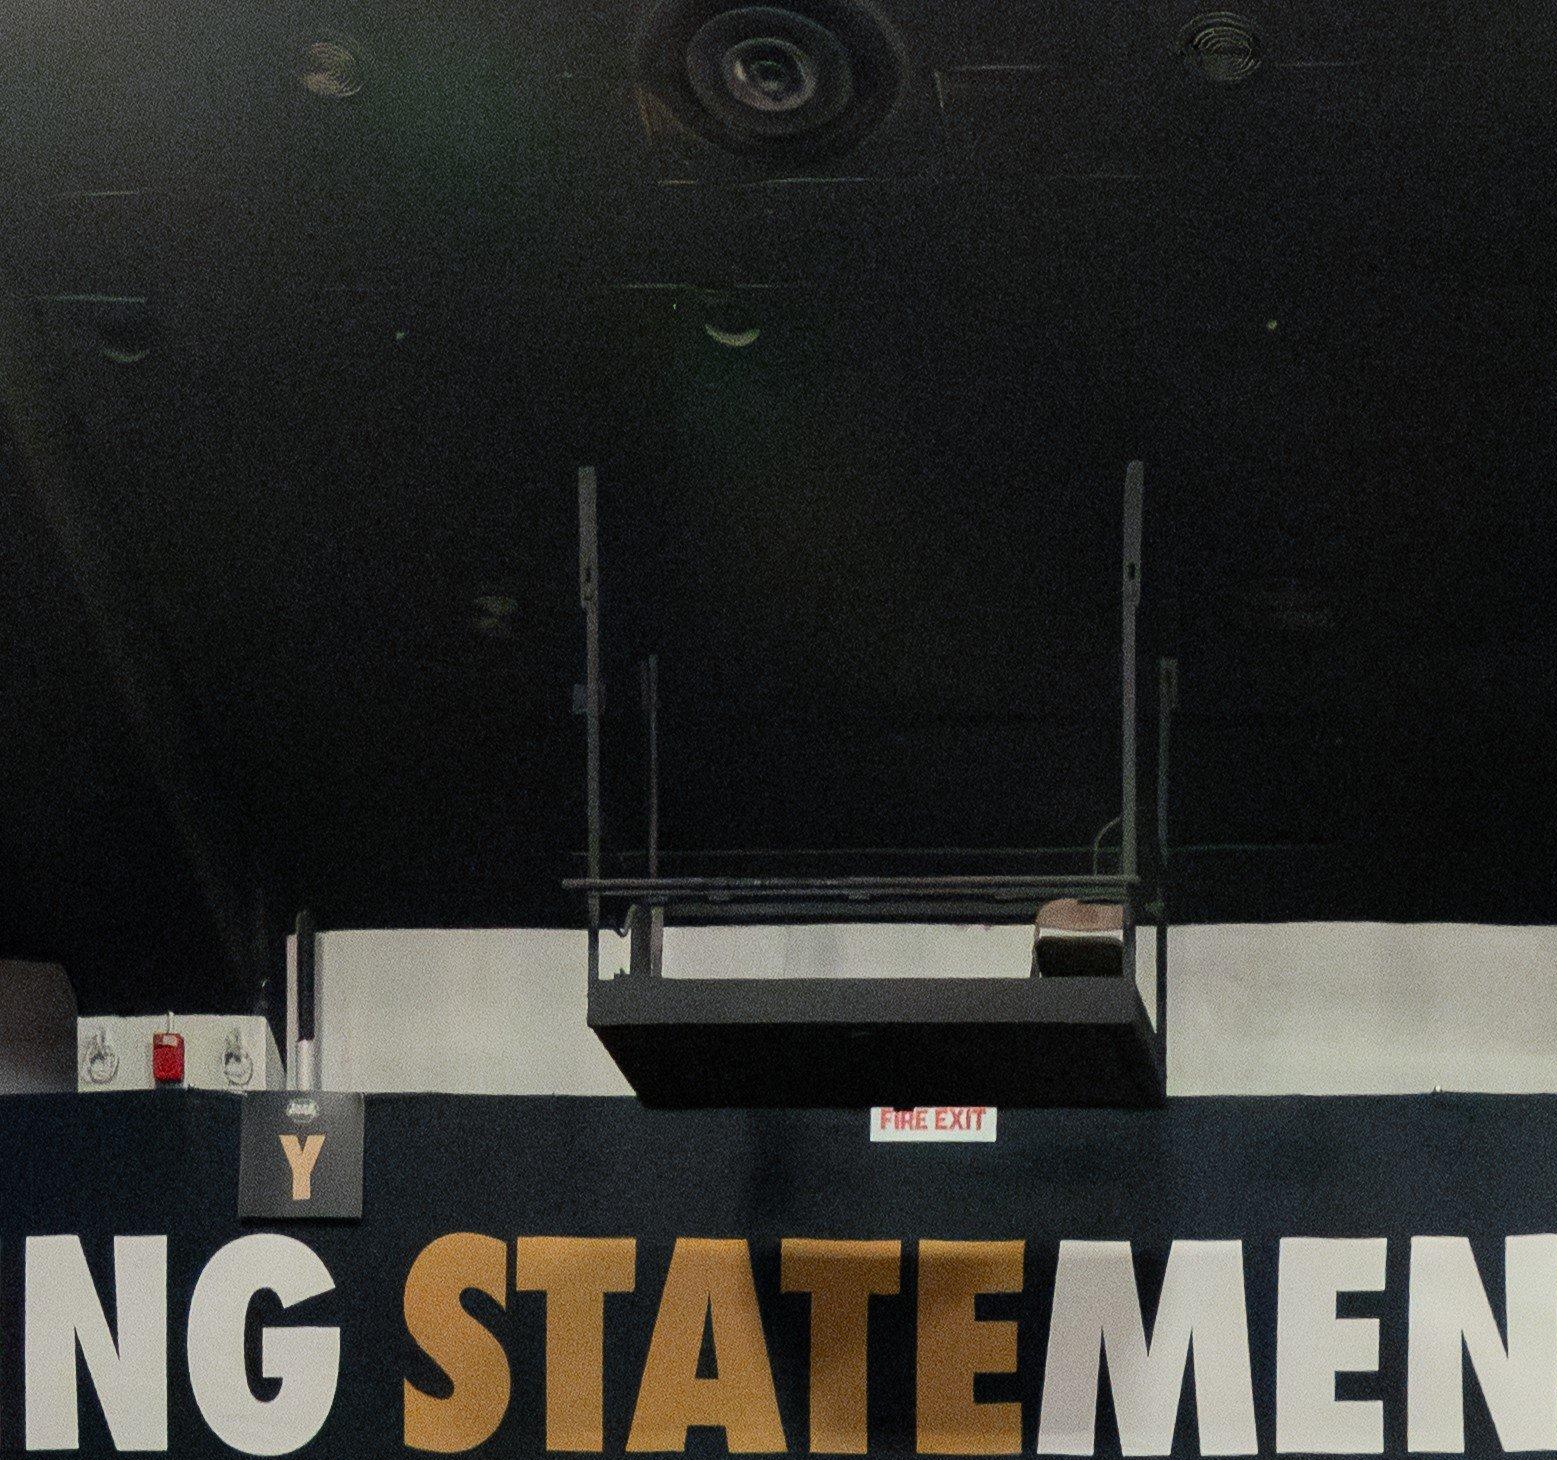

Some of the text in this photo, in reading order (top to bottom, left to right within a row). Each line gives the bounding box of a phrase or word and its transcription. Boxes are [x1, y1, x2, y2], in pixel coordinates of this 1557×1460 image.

[880, 1105, 987, 1131] FIRE EXIT
[278, 1133, 327, 1201] Y
[25, 1233, 341, 1458] NG
